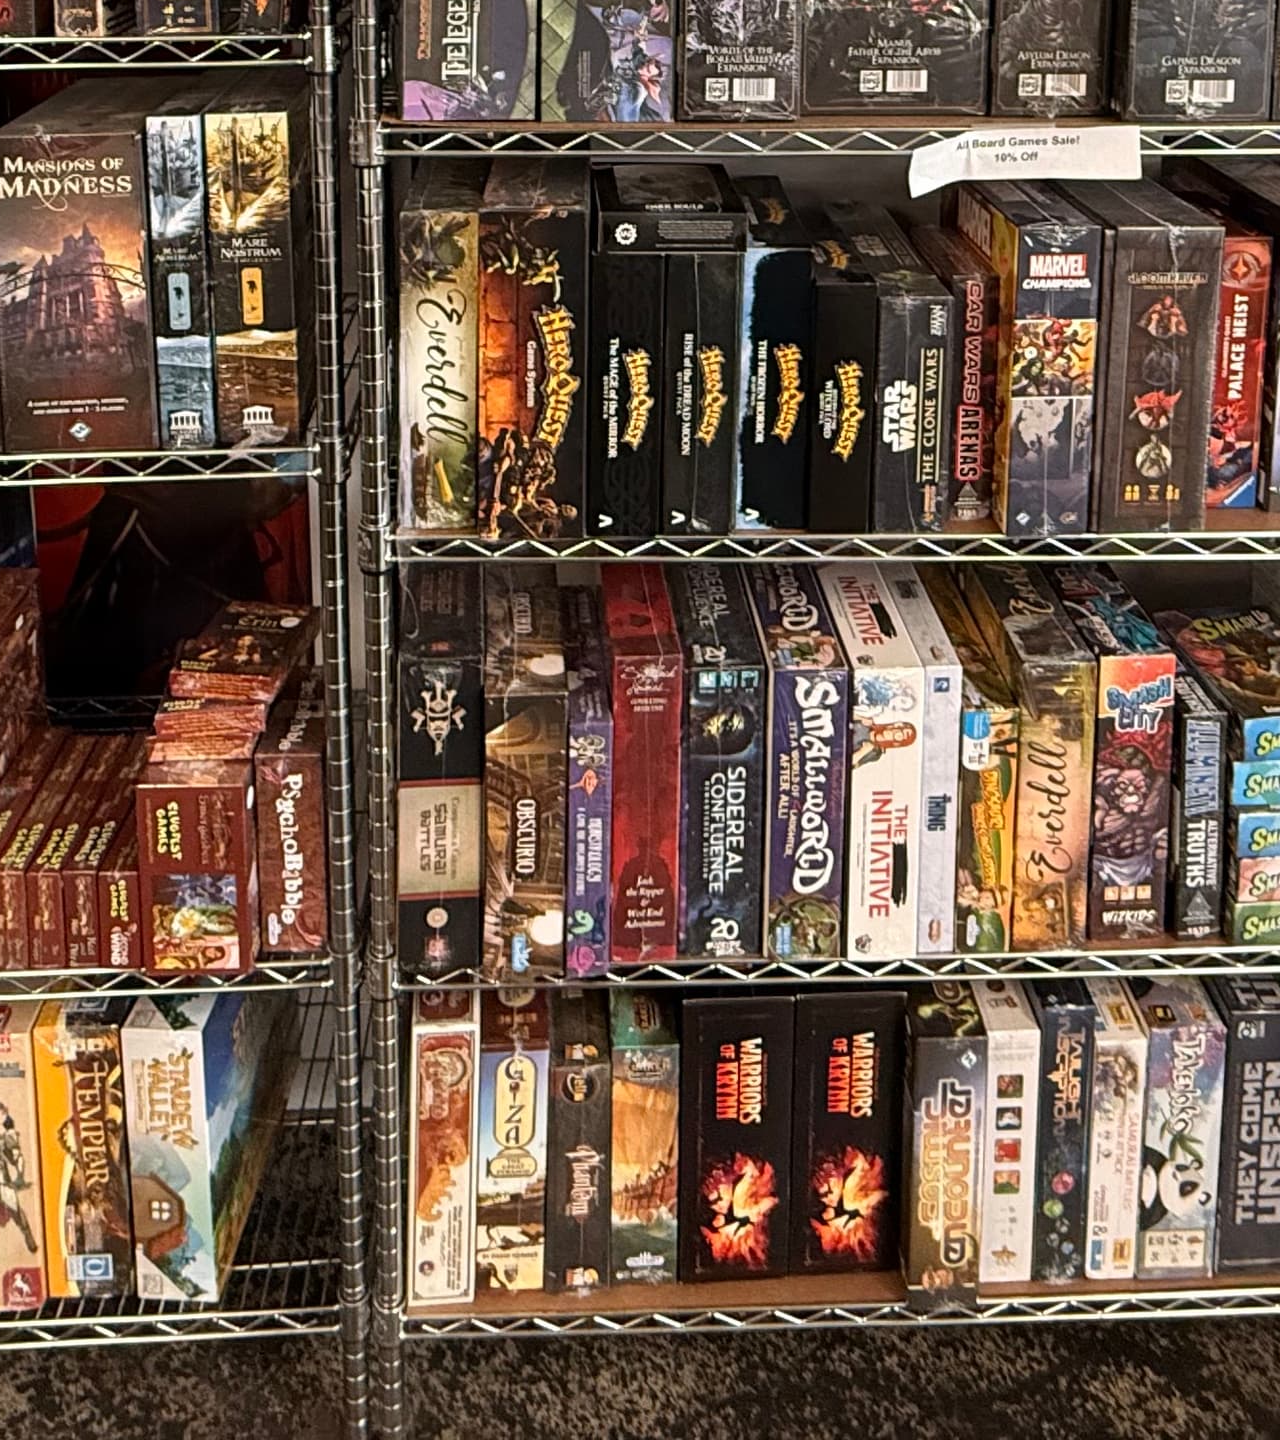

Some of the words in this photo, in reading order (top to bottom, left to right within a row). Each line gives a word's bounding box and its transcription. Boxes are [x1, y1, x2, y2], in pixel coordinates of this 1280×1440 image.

[1017, 51, 1051, 61] ASYLUM
[1055, 51, 1090, 60] DEMON
[3, 157, 96, 175] MANSIONS
[101, 157, 123, 170] OF
[956, 140, 969, 150] All
[972, 138, 1006, 149] Board
[1010, 136, 1048, 147] Games
[1052, 136, 1080, 146] Sale!
[994, 152, 1017, 163] 10%
[1021, 151, 1039, 161] Off
[221, 248, 282, 258] NOSTRUM
[232, 238, 269, 248] MARE
[1030, 255, 1087, 277] MARVEL
[1022, 279, 1091, 289] CHAMPIONS
[1233, 294, 1249, 339] HEIST
[416, 289, 467, 446] Everdell
[924, 347, 939, 394] WARS
[1227, 345, 1245, 400] PALACE
[922, 398, 937, 457] CLONE
[957, 405, 981, 480] ARENAS
[922, 462, 935, 483] THE
[516, 799, 536, 875] OBSCURIO
[707, 772, 724, 893] CONFLUENCE
[726, 766, 745, 880] SIDEREAL
[1027, 741, 1072, 882] Everdell
[869, 791, 893, 919] INITIATIVE
[1186, 820, 1206, 889] TRUTHS
[1206, 820, 1218, 889] ALTERNATIVE
[1103, 909, 1156, 924] WIZKIDS
[718, 1043, 735, 1057] OF
[832, 1037, 844, 1052] OF
[716, 1060, 739, 1120] KRYNN
[739, 1037, 763, 1125] WARRIORS
[828, 1055, 851, 1114] KRYNN
[851, 1032, 874, 1118] WARRIORS
[1240, 1062, 1264, 1142] COME
[1236, 1152, 1256, 1225] THEY
